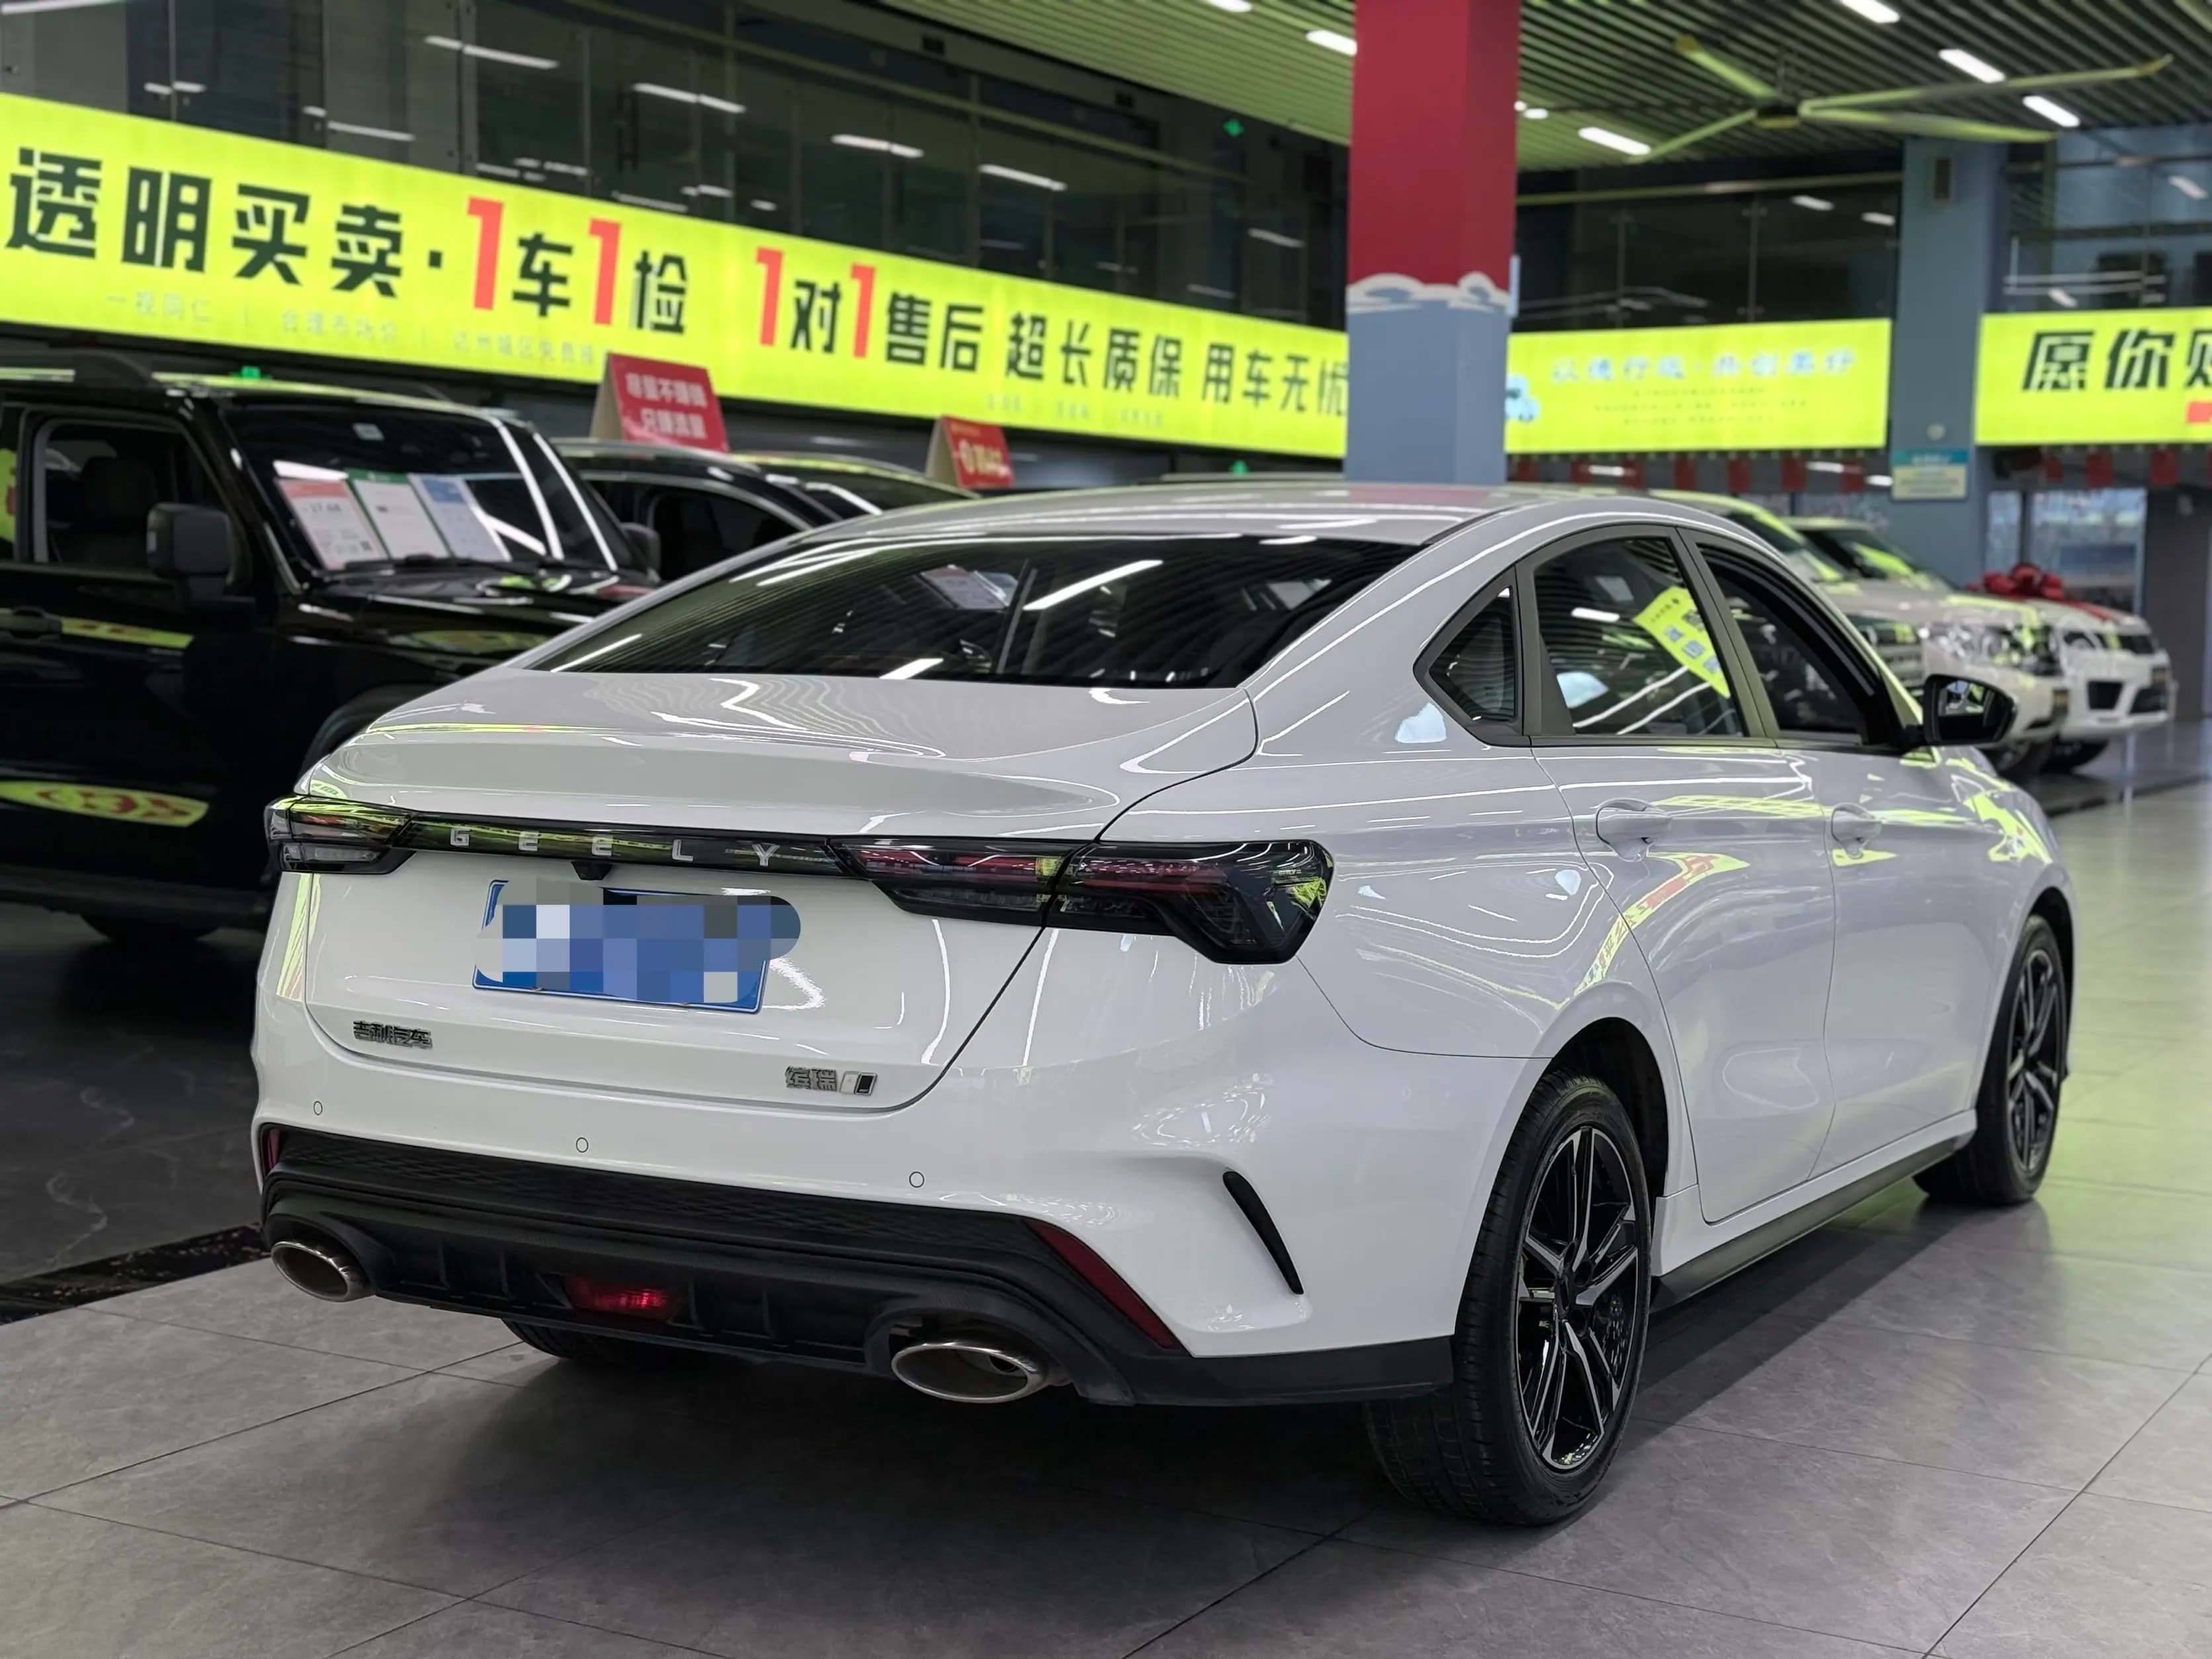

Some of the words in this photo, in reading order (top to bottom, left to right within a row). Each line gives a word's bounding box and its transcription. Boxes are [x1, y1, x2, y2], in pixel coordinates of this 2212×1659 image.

[756, 248, 983, 371] 1对1售后
[1007, 312, 1181, 398] 超长质保
[450, 828, 780, 867] GEELY
[353, 1021, 433, 1048] 吉利汽车
